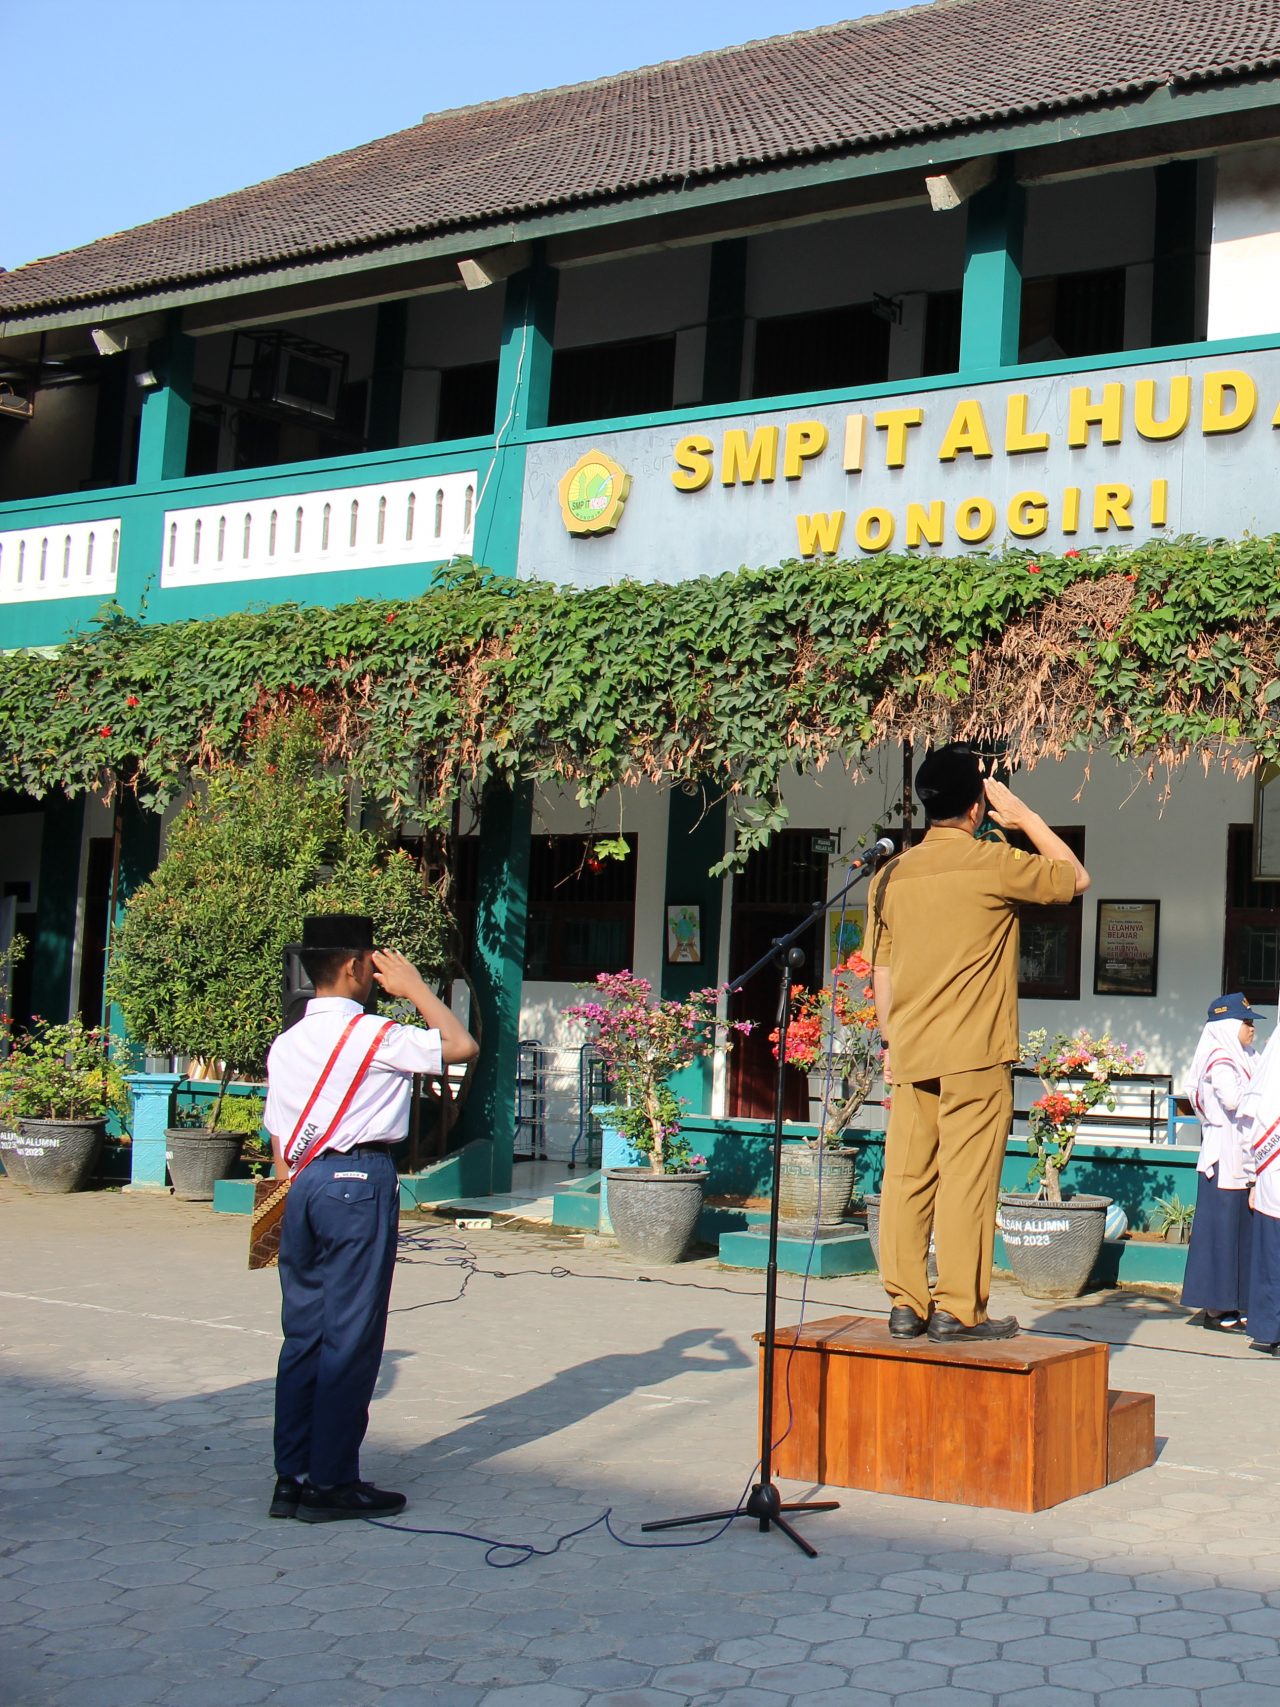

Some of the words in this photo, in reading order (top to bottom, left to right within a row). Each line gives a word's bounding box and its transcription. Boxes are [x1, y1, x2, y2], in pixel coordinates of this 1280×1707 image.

[671, 421, 830, 490] SMP
[845, 408, 925, 471] IT
[937, 394, 1051, 461] AL
[795, 480, 1169, 557] WONOGIRI
[1107, 931, 1138, 940] BELAJAR
[1023, 1219, 1070, 1232] ALUMNI
[1023, 1234, 1050, 1246] 2023
